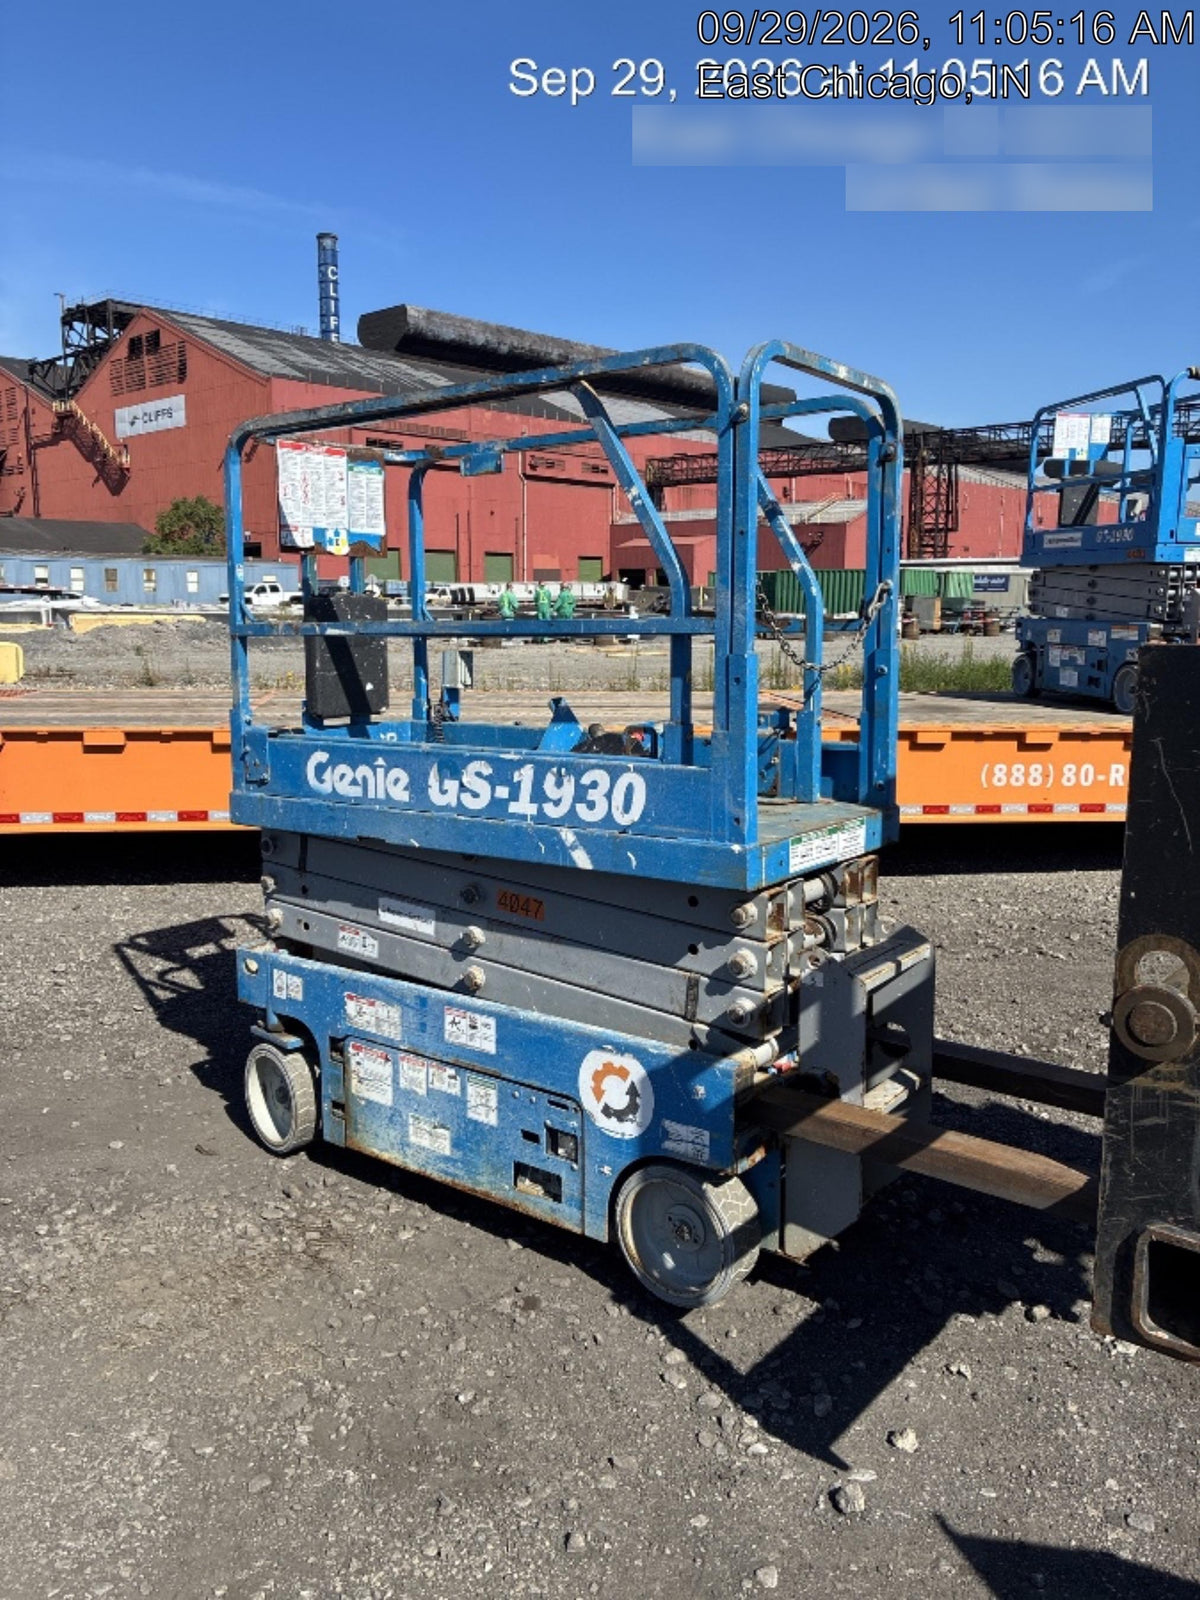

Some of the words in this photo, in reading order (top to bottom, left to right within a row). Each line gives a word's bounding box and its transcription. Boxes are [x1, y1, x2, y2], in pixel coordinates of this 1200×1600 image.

[306, 751, 410, 803] Genie
[428, 759, 648, 827] GS-1930
[981, 763, 1054, 788] (888)
[1061, 763, 1126, 788] 80-R
[498, 891, 544, 920] 4047
